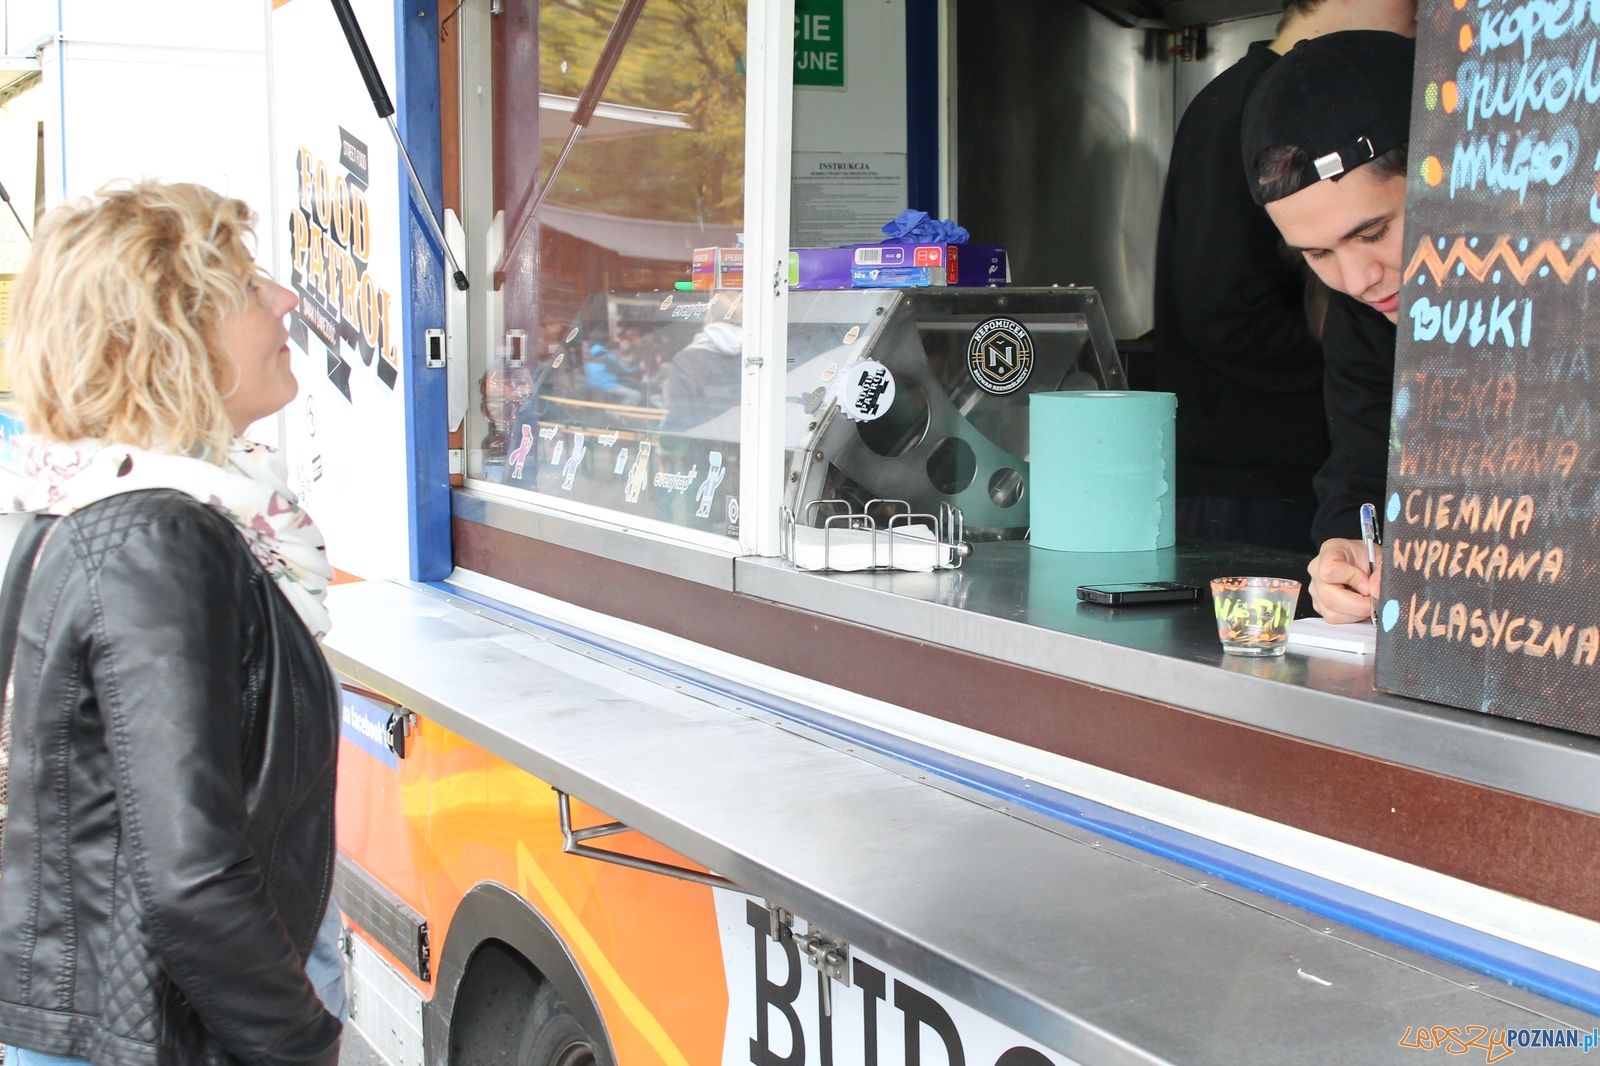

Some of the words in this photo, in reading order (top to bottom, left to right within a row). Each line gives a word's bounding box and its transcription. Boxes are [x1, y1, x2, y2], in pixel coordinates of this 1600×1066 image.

[794, 51, 838, 71] JNE
[819, 162, 870, 171] INSTRUKCJA
[299, 146, 371, 264] FOOD
[291, 207, 398, 368] PATROL
[974, 320, 1025, 341] NEPOMUCEN
[1409, 296, 1533, 348] BUŁKI
[973, 368, 993, 389] BROWAR
[988, 346, 1012, 367] N
[855, 375, 874, 408] FOOD
[860, 368, 886, 415] PATROL
[1405, 489, 1535, 540] CIEMNA
[1392, 537, 1565, 584] WYPIEKANA
[1407, 592, 1600, 667] KLASYCZNA
